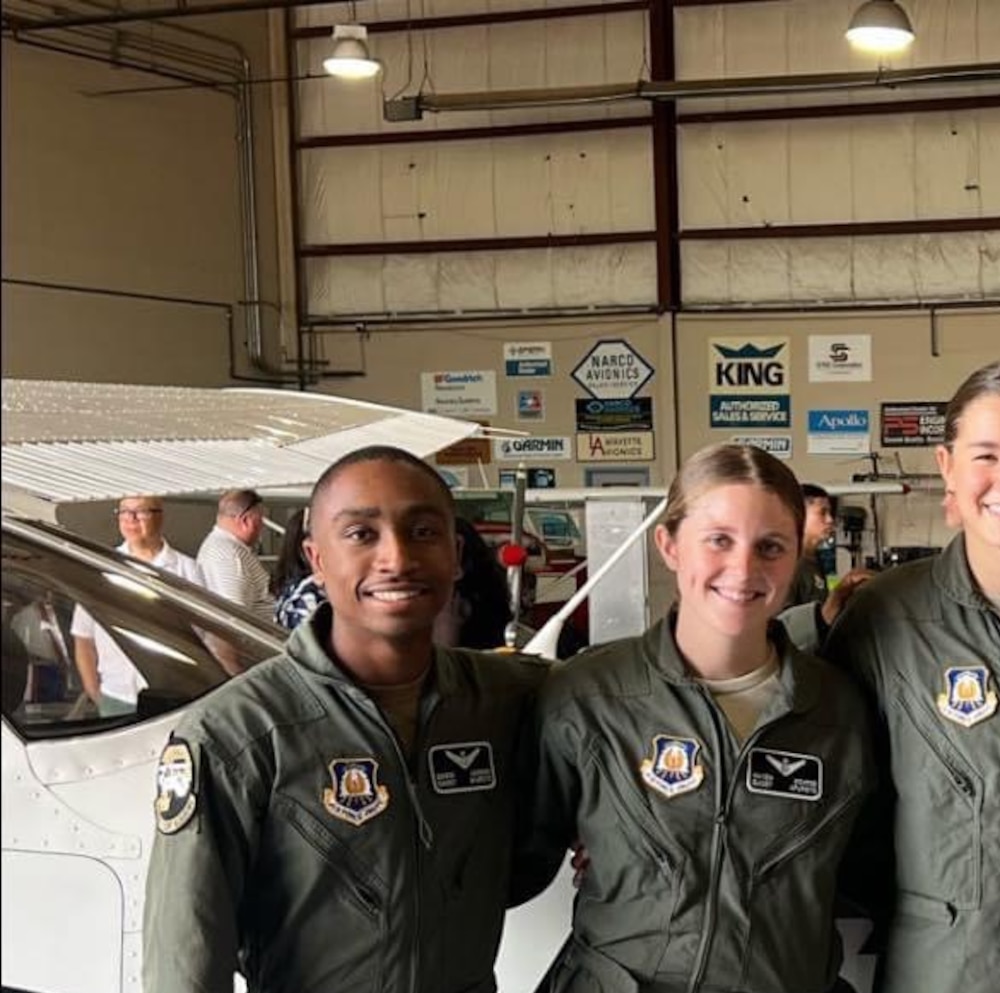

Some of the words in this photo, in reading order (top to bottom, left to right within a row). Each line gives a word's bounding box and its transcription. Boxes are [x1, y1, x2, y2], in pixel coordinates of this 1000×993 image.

[592, 354, 634, 367] NARCO
[586, 368, 639, 381] AVIONICS
[716, 362, 784, 386] KING
[720, 400, 780, 411] AUTHORIZED
[712, 411, 742, 421] SALES
[750, 411, 787, 421] SERVICE
[818, 413, 866, 430] Apollo
[513, 438, 563, 451] GARMIN
